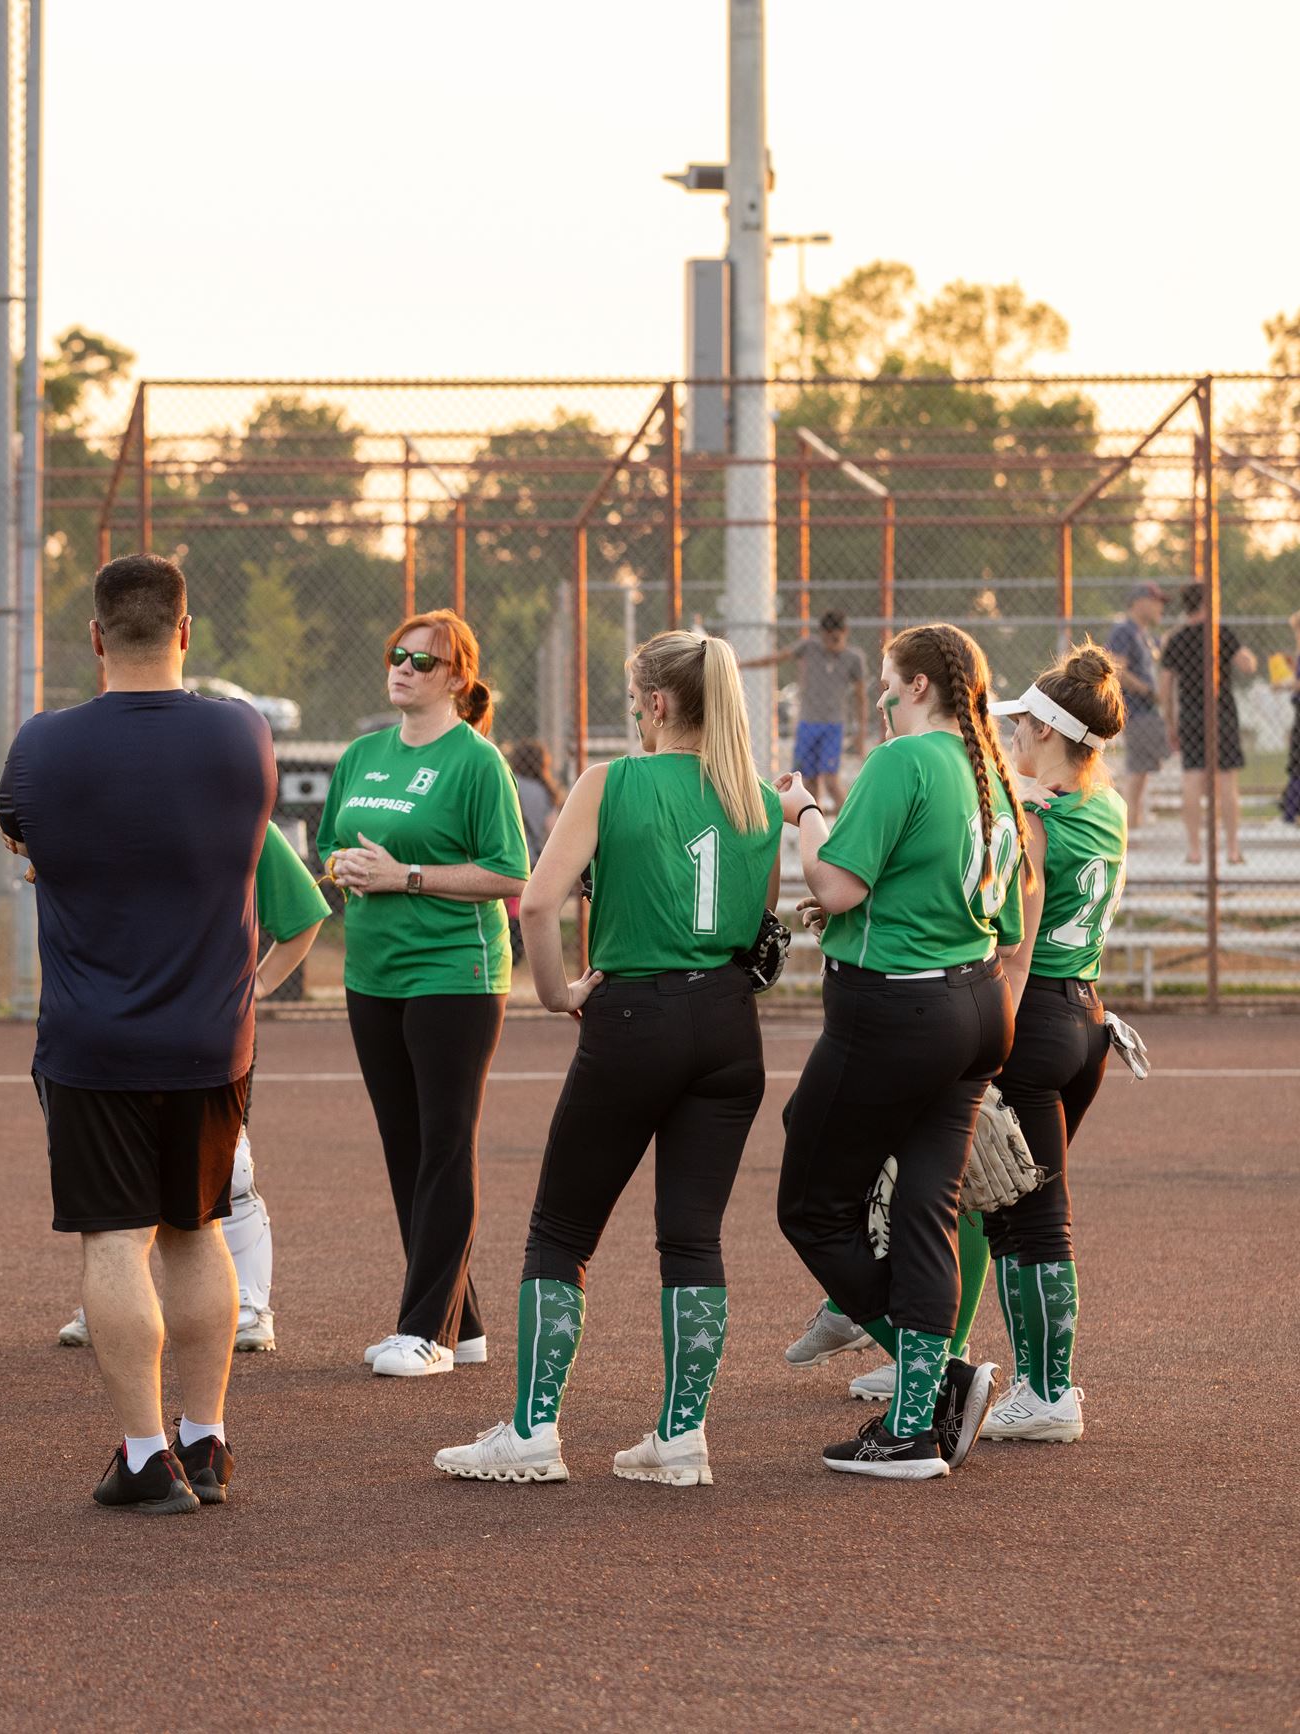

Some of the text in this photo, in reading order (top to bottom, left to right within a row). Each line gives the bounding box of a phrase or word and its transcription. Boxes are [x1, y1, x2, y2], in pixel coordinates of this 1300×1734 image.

[346, 797, 416, 814] RAMPAGE
[685, 825, 719, 934] 1
[962, 808, 1019, 919] 10
